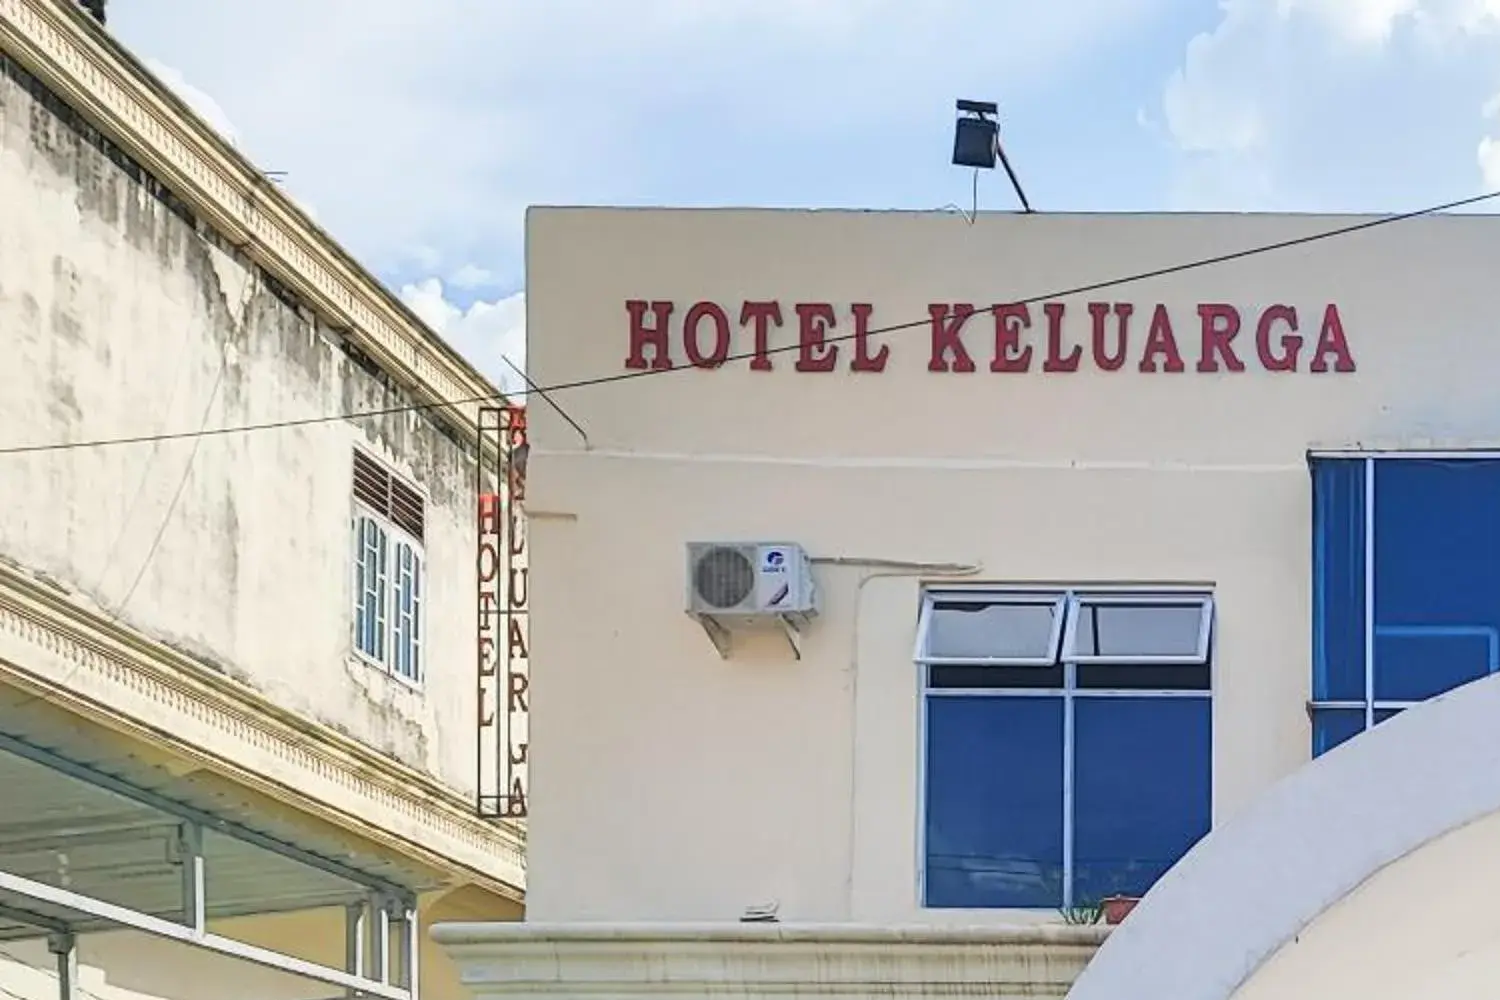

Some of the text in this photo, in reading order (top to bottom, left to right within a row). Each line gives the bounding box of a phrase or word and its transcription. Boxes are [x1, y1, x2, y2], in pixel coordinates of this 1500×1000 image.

[624, 300, 1357, 373] HOTEL KELUARGA
[478, 494, 499, 727] HOTEL
